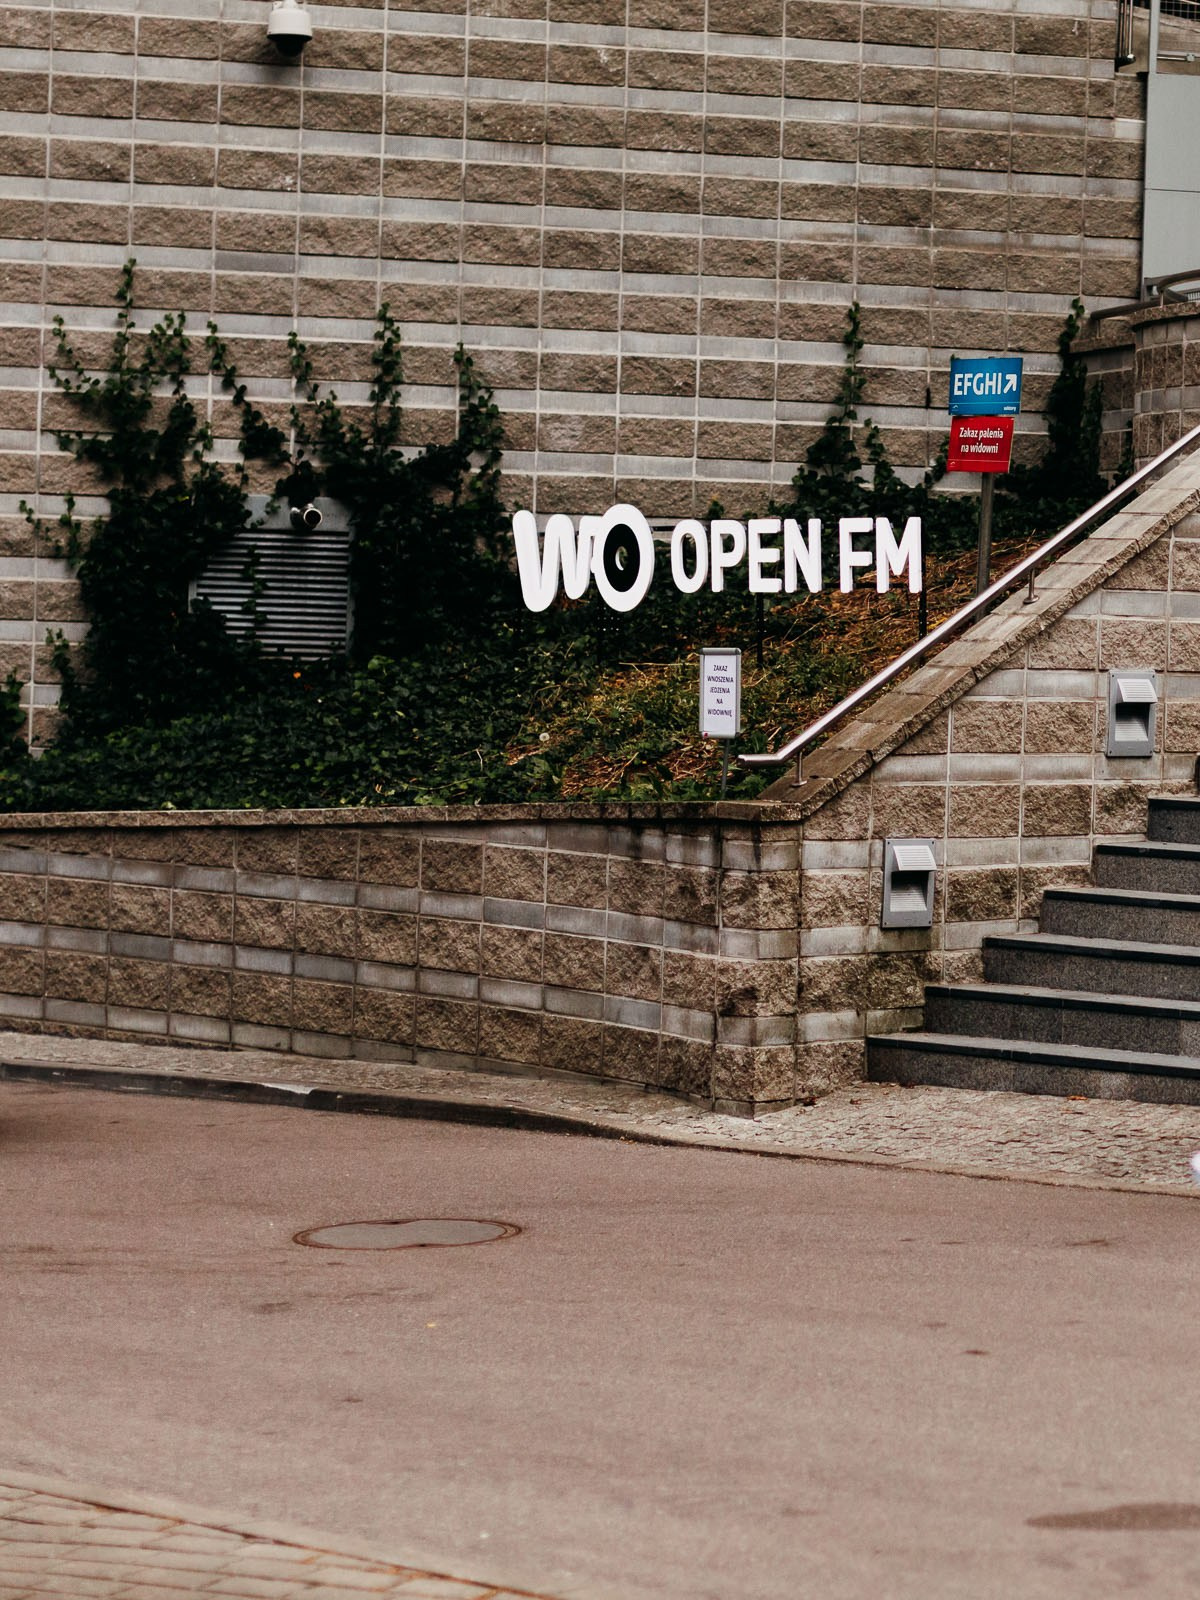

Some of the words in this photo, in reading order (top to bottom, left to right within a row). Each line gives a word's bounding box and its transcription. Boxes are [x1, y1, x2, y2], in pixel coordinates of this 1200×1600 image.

[953, 372, 1002, 396] EFGHI
[959, 427, 979, 438] Zakaz
[978, 428, 1004, 441] palenia
[960, 444, 970, 453] na
[970, 442, 999, 454] widowni
[670, 518, 823, 594] OPEN
[838, 516, 923, 594] FM
[707, 709, 732, 717] WIDOWNIĘ
